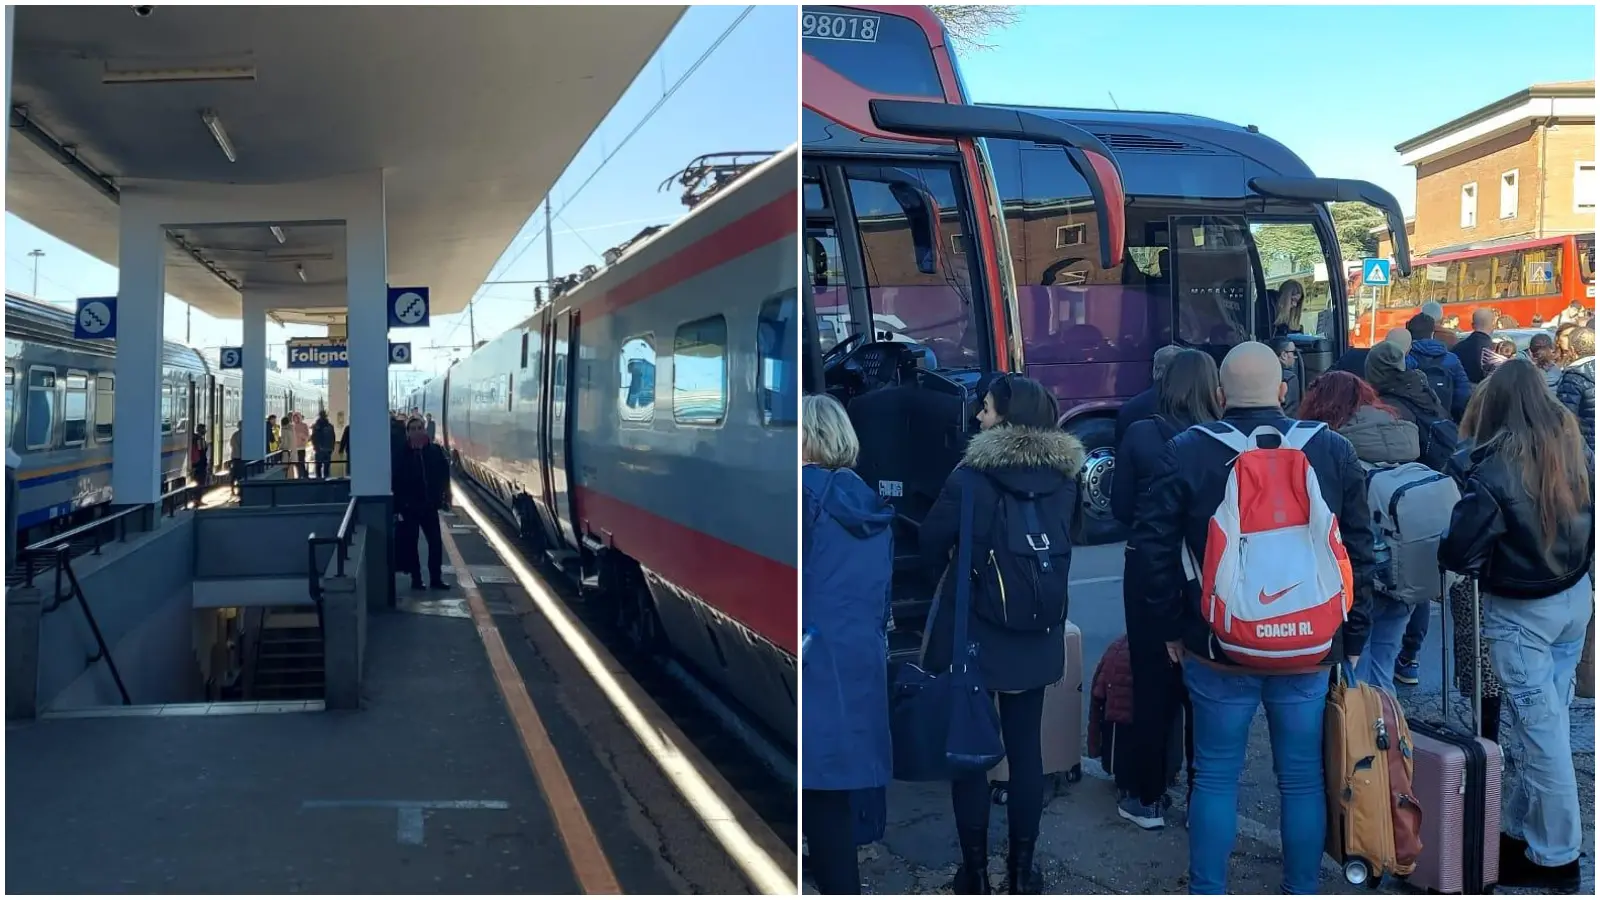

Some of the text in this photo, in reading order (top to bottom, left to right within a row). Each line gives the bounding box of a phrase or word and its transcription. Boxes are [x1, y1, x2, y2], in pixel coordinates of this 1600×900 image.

[802, 14, 875, 39] 98018
[226, 352, 235, 364] 5
[290, 348, 348, 365] Foligno
[395, 347, 405, 359] 4
[1256, 620, 1314, 638] COACH RL
